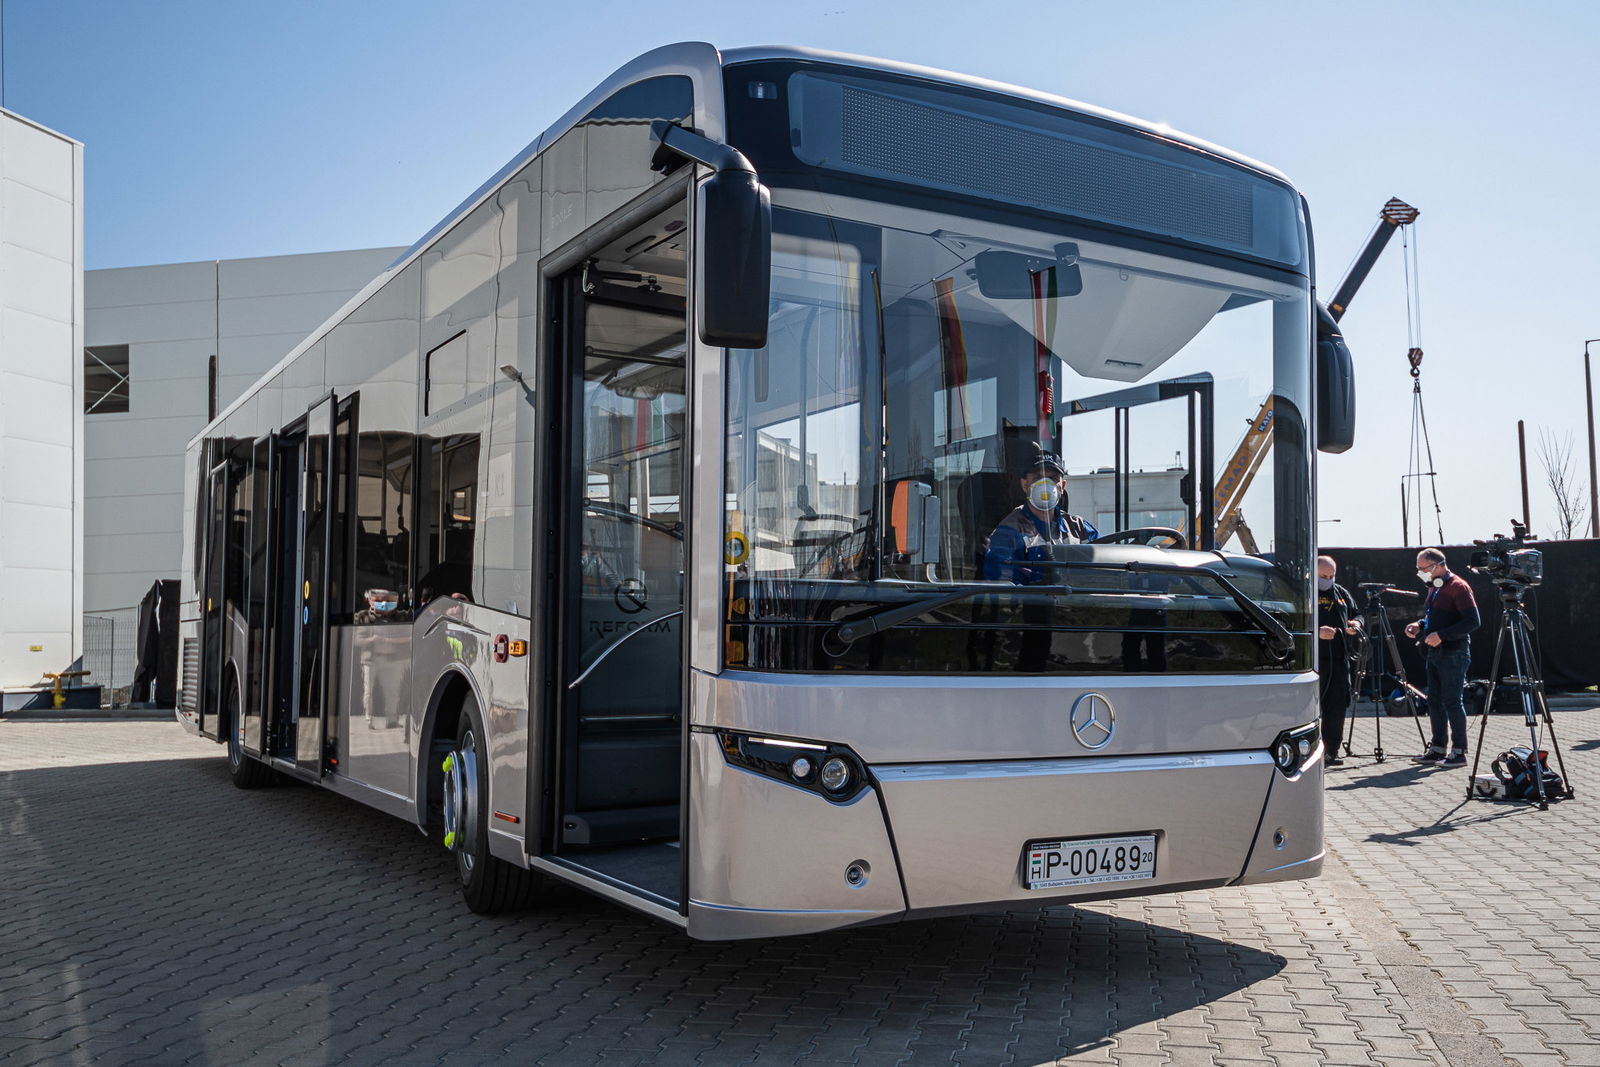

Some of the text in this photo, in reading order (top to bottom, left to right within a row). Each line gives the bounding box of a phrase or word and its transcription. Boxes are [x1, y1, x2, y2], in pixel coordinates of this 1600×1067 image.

[1258, 410, 1274, 432] KATO
[1046, 845, 1153, 879] P-00489 20
[1031, 867, 1041, 880] H
